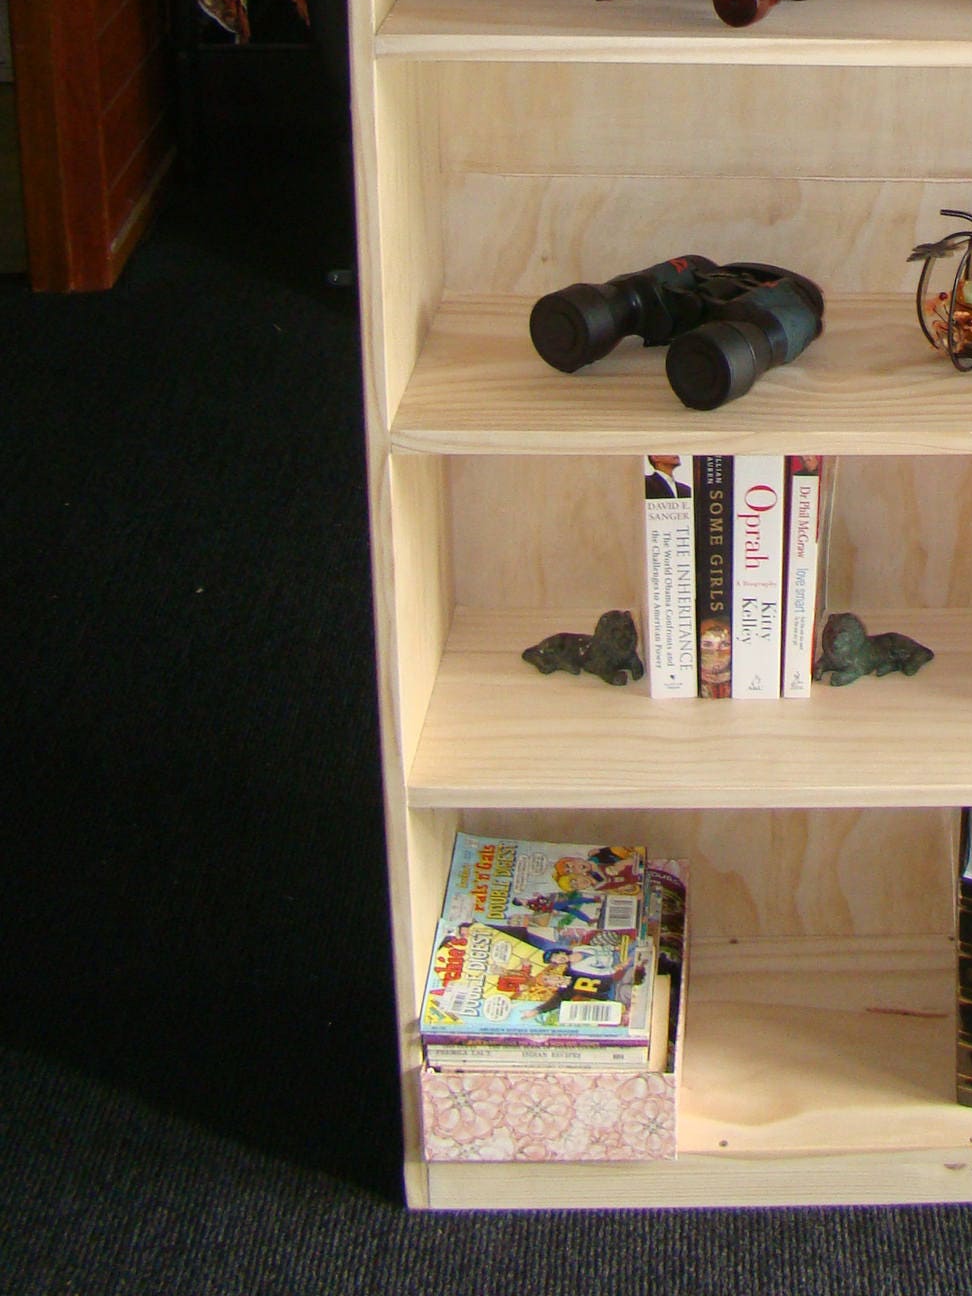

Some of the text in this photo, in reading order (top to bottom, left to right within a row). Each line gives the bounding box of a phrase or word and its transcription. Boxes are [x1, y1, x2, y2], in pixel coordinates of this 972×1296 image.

[648, 502, 680, 512] DAVID
[649, 511, 690, 521] SANGER
[736, 484, 778, 569] Oprah
[797, 485, 811, 558] Dr Phil McGraw
[650, 545, 662, 591] Challenges
[709, 490, 724, 612] SOME GIRLS
[663, 532, 675, 667] The World Obama Confronts and
[676, 525, 693, 671] THE INHERITANCE
[761, 601, 777, 641] Kitty
[653, 603, 663, 642] American
[736, 598, 757, 647] Kelley
[487, 879, 511, 919] DOUBLE
[468, 930, 494, 974] DIGEST
